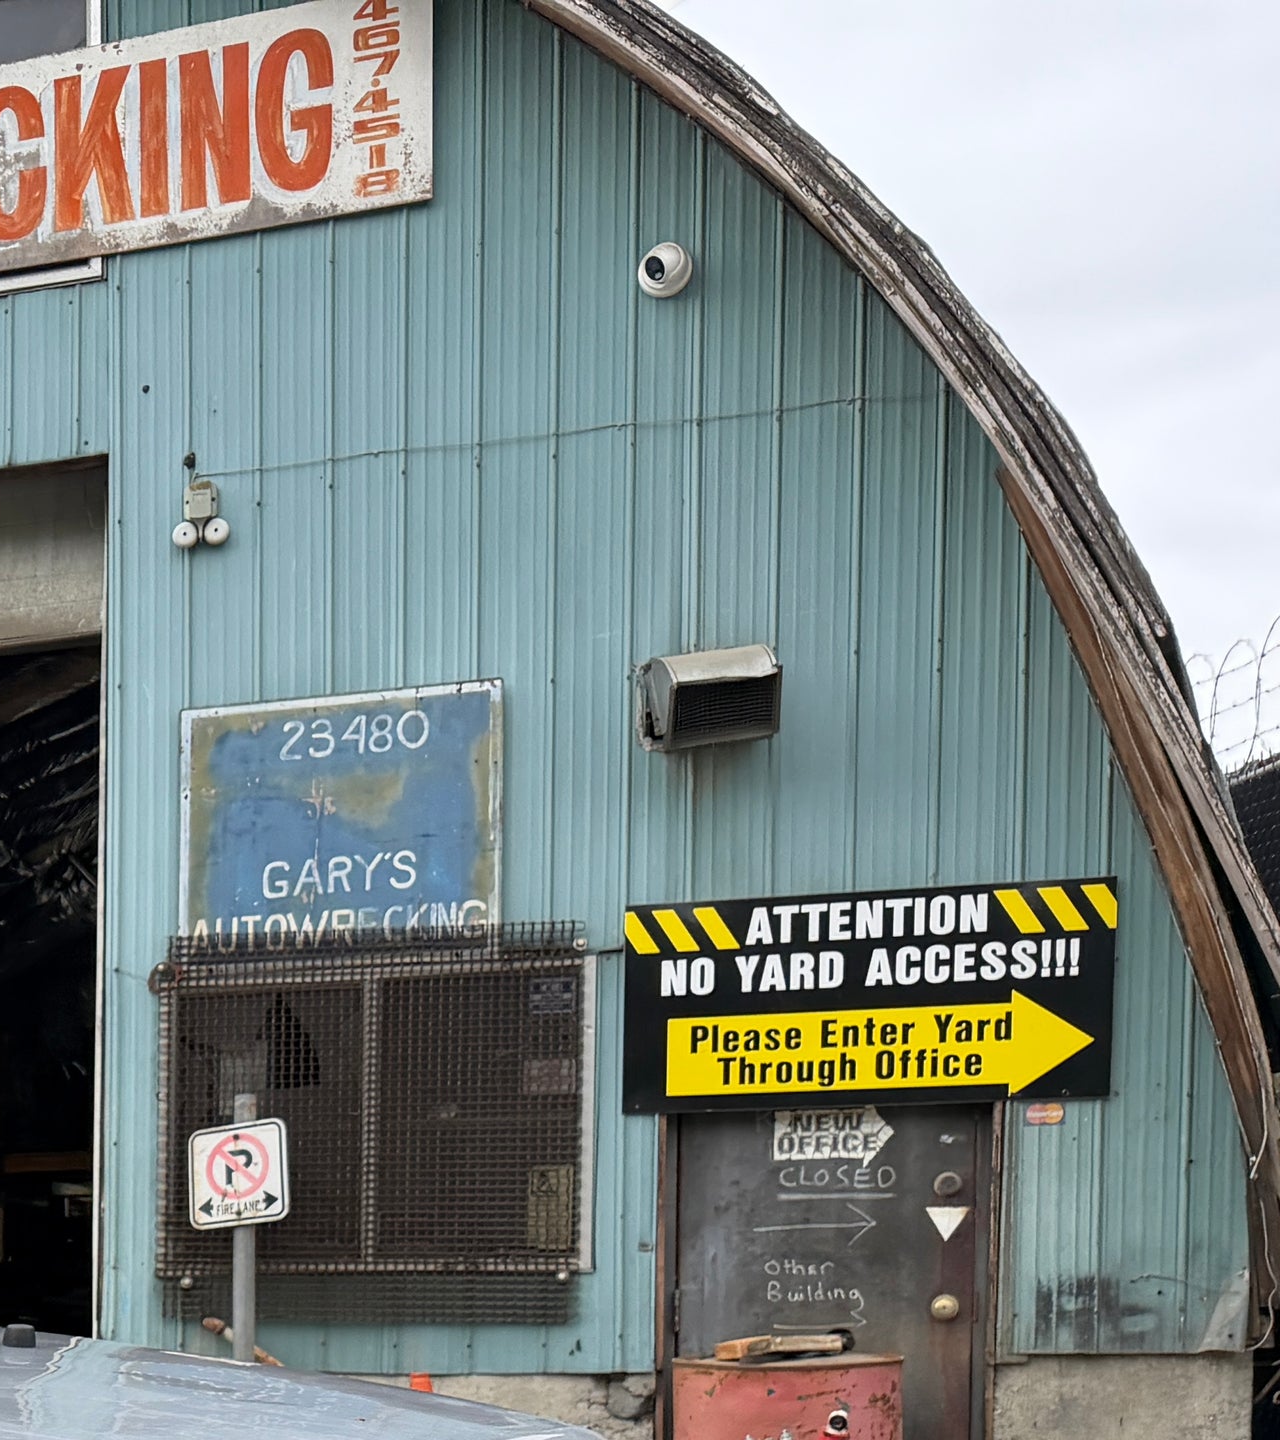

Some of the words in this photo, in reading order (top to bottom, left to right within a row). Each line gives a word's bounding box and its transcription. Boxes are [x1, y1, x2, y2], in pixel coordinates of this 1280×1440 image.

[278, 709, 430, 761] 23480
[262, 849, 418, 900] GARY'S
[744, 892, 990, 947] ATTENTION
[659, 956, 716, 997] NO
[734, 949, 846, 994] YARD
[863, 936, 1082, 988] ACCESS!!!
[690, 1024, 803, 1054] Please
[820, 1017, 917, 1049] Enter
[933, 1010, 1014, 1043] Yard
[716, 1051, 858, 1088] Through
[874, 1047, 984, 1080] Office
[790, 1112, 863, 1133] NEW
[777, 1131, 880, 1156] OFFICE
[778, 1164, 898, 1189] CLOSED
[763, 1258, 835, 1277] Other
[766, 1280, 866, 1314] Building
